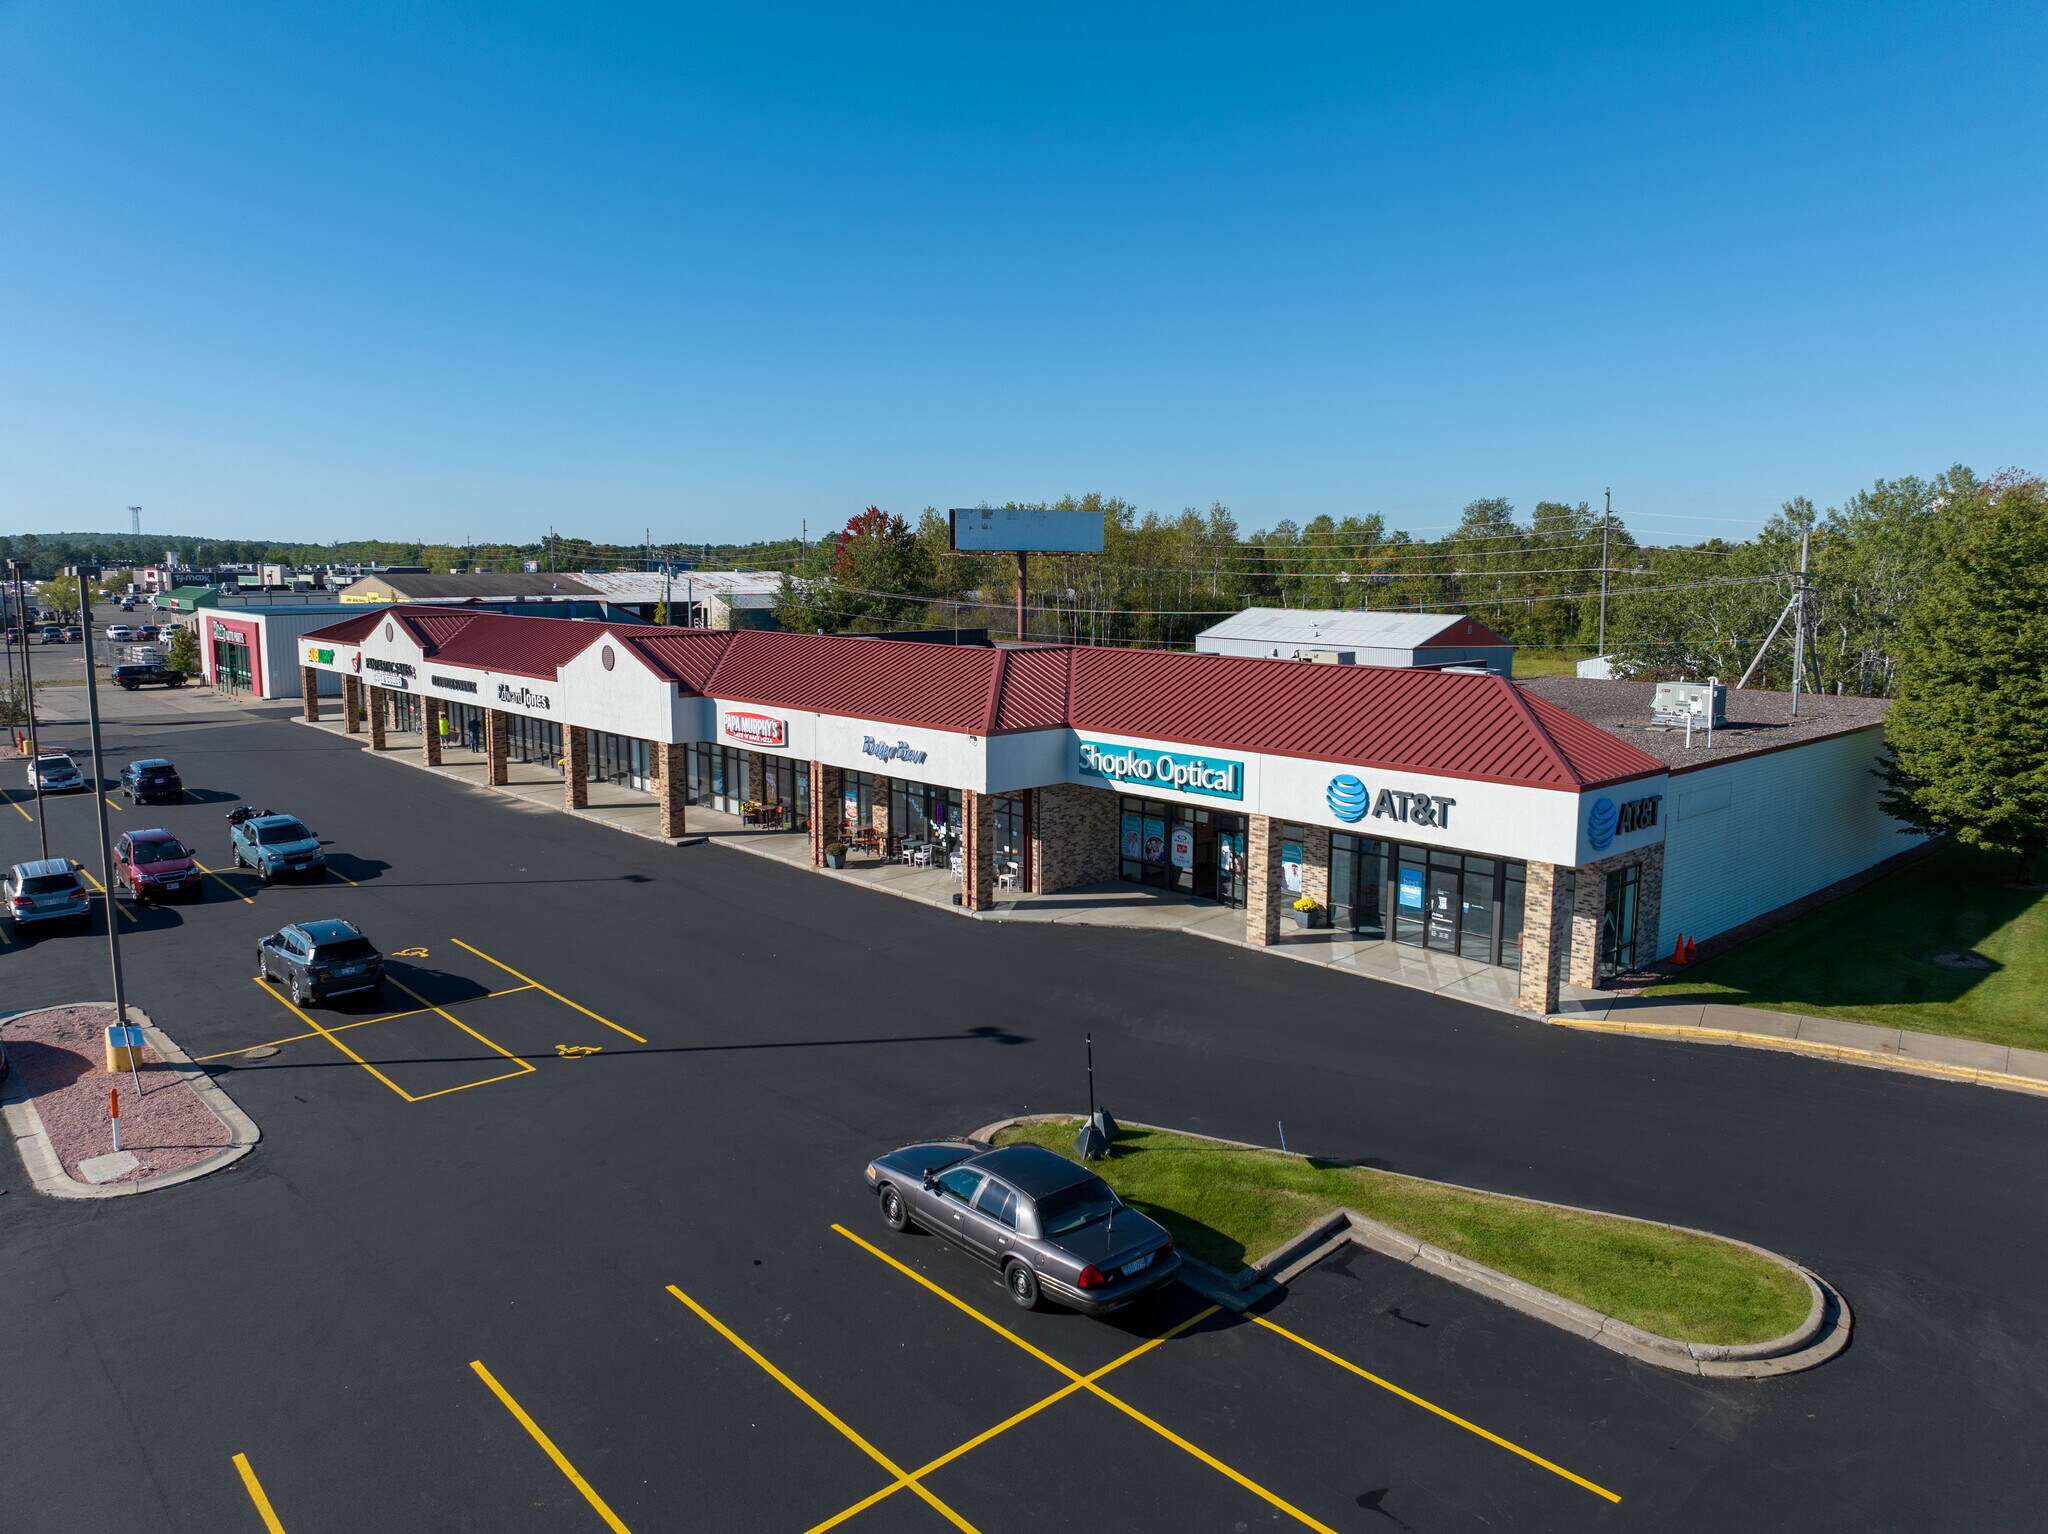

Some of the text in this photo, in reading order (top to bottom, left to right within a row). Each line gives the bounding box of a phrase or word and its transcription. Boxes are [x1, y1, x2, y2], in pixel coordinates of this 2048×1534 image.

[521, 687, 550, 710] Jones
[724, 714, 779, 738] PAPA MURPHY'S
[1079, 744, 1237, 793] Shopko Optical
[1372, 788, 1456, 829] AT&T
[1615, 794, 1662, 836] AT&T
